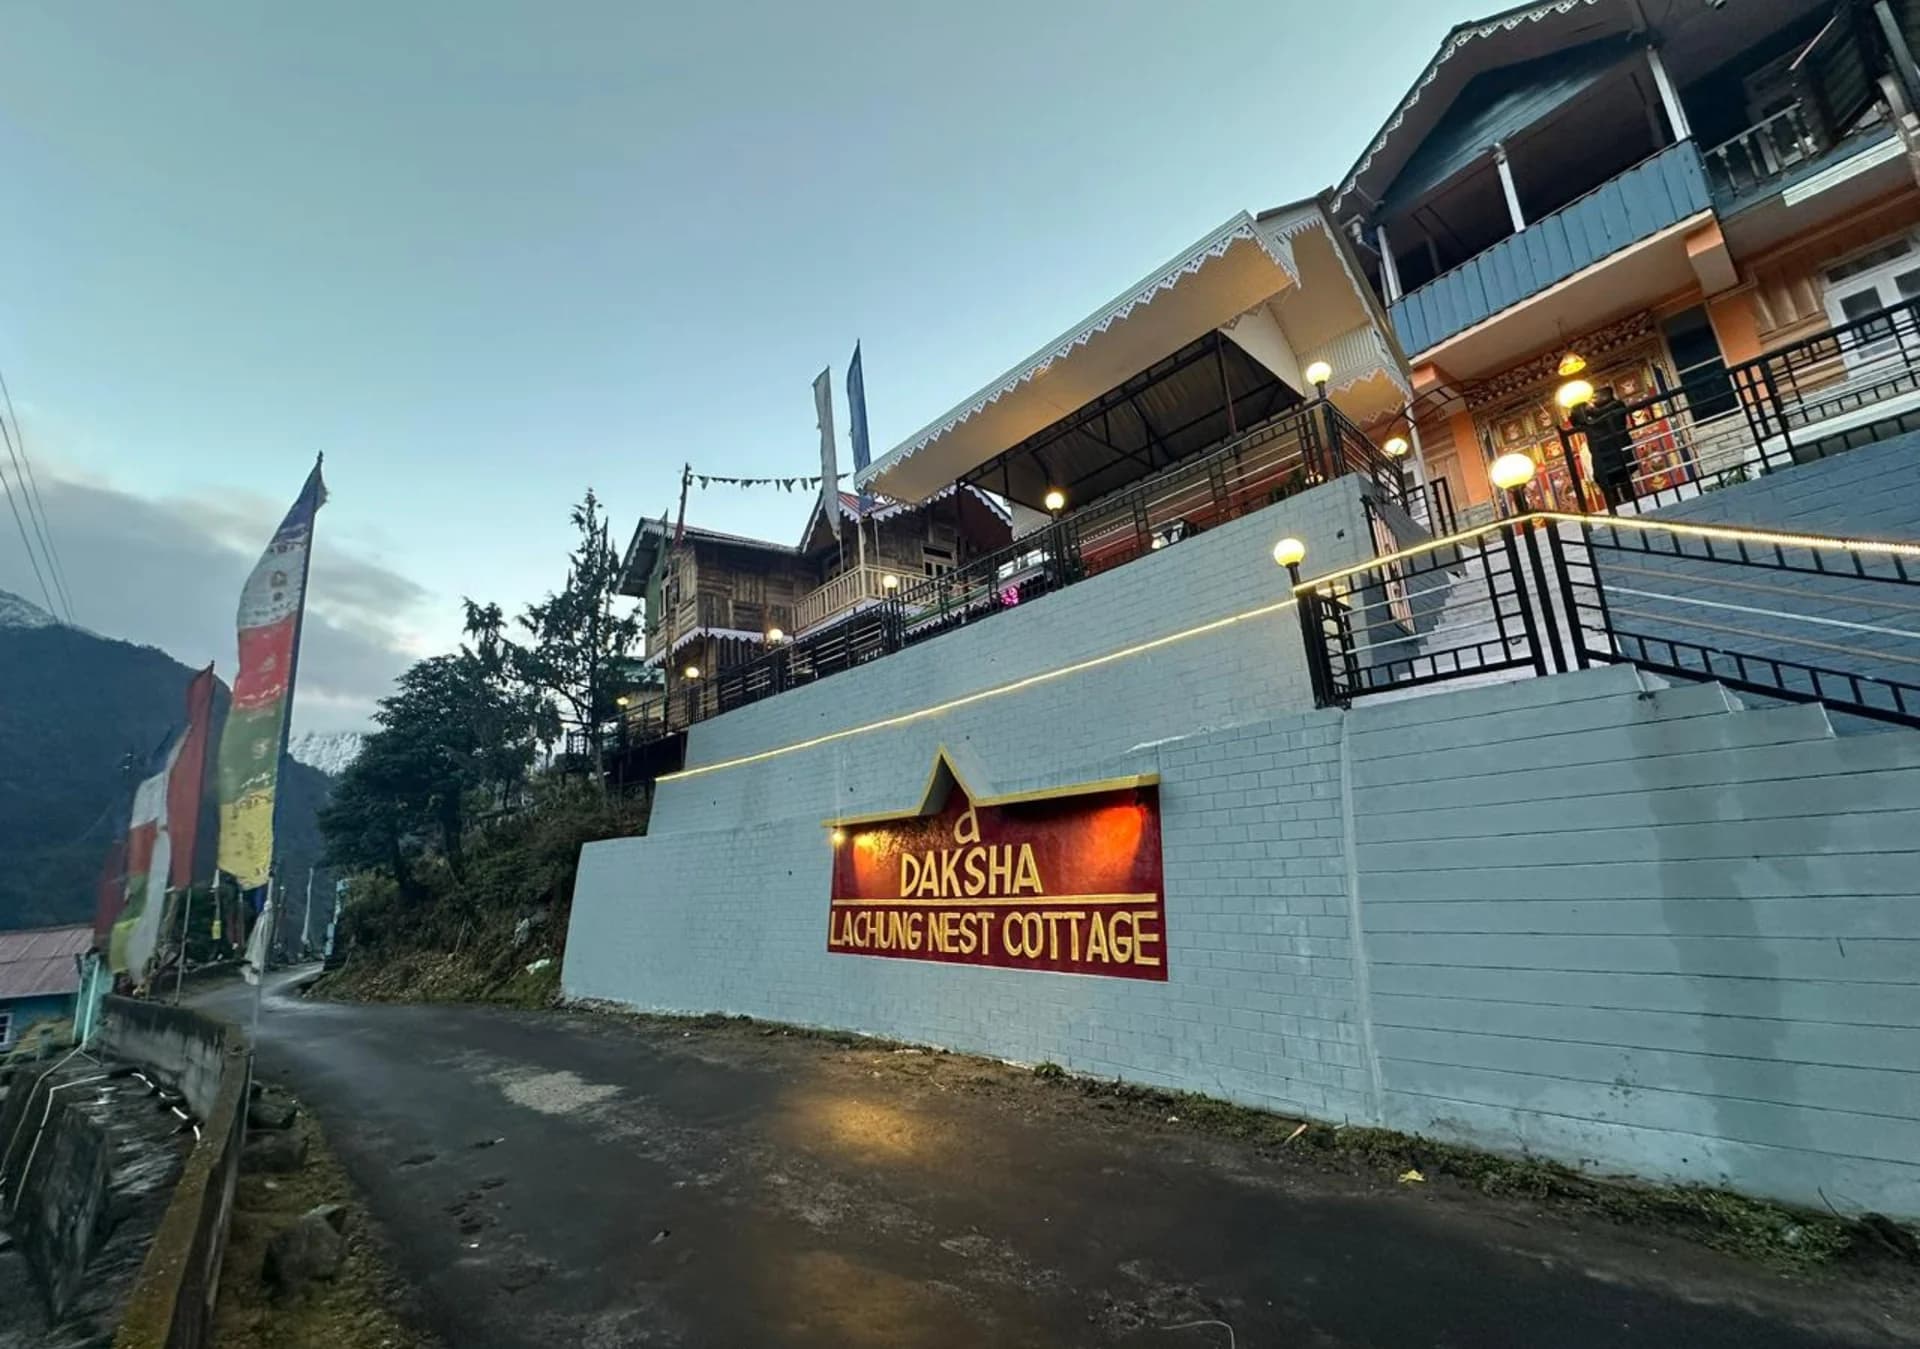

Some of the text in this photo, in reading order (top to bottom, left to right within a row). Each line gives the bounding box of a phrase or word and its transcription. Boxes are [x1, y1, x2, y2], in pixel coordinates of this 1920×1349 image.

[900, 843, 1043, 898] DAKSHA
[829, 911, 1160, 966] LACHUNG NEST COTTAGE
